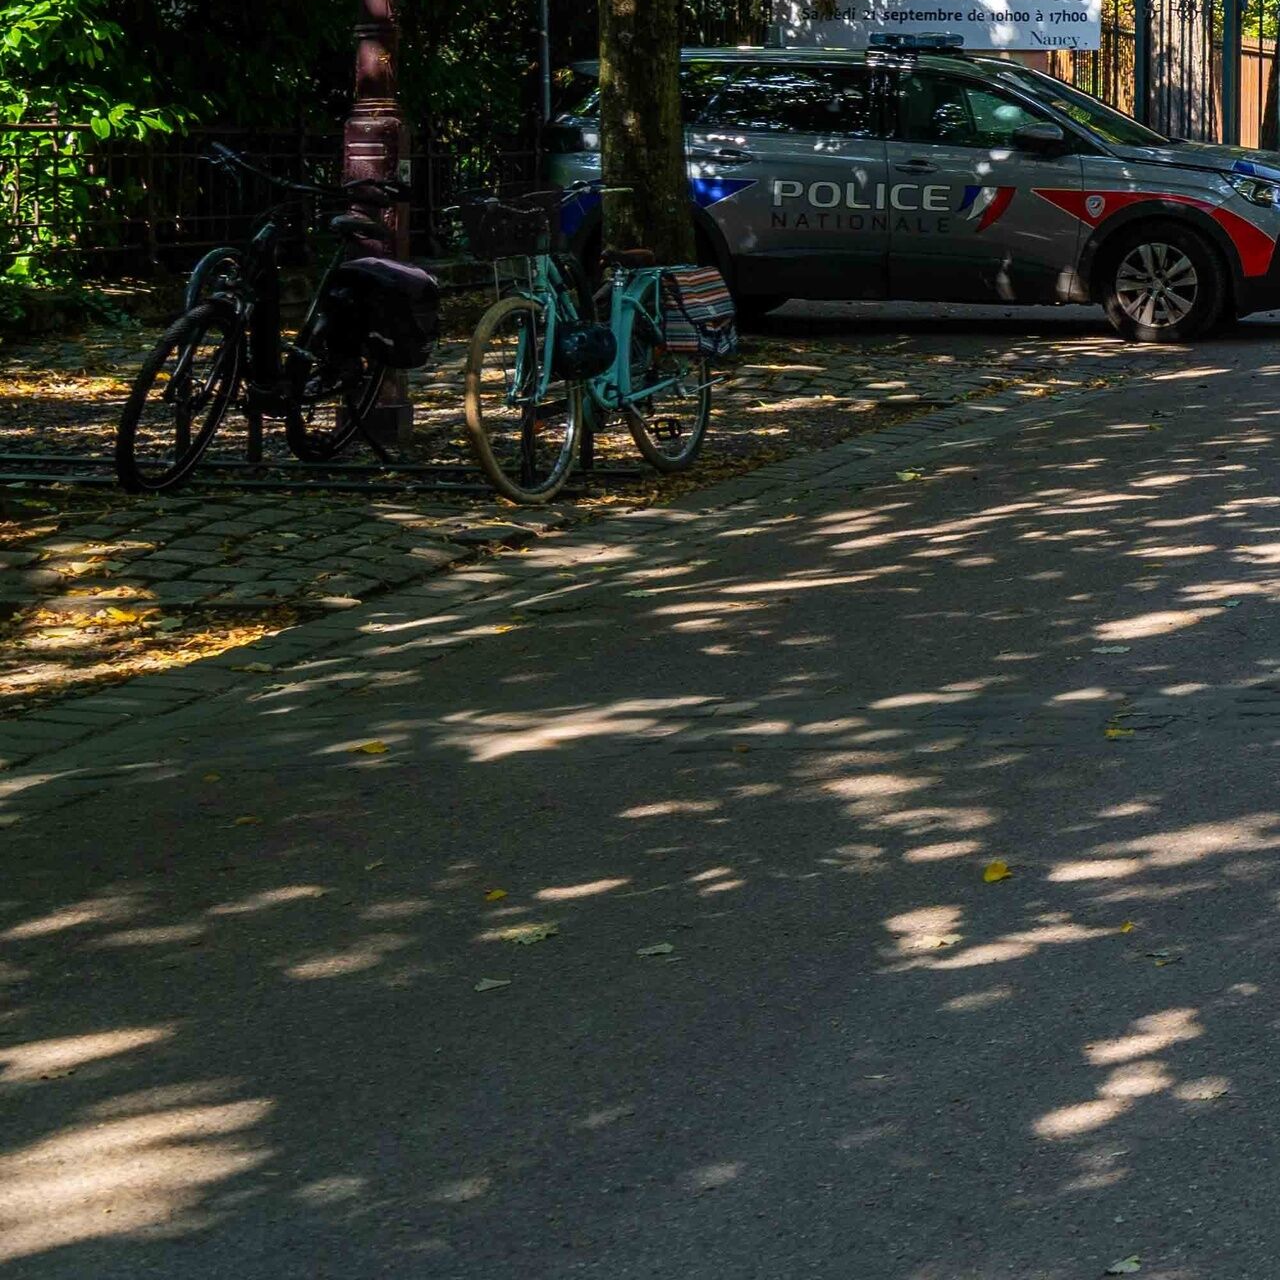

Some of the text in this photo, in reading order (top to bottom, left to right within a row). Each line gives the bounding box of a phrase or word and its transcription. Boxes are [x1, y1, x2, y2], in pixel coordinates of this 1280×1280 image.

[863, 9, 877, 21] 21
[884, 8, 963, 24] septembre
[968, 9, 985, 22] de
[991, 10, 1030, 22] 10h00
[1036, 10, 1044, 22] à
[1050, 10, 1088, 25] 17h00
[773, 180, 951, 211] POLICE
[771, 213, 951, 234] NATIONALE
